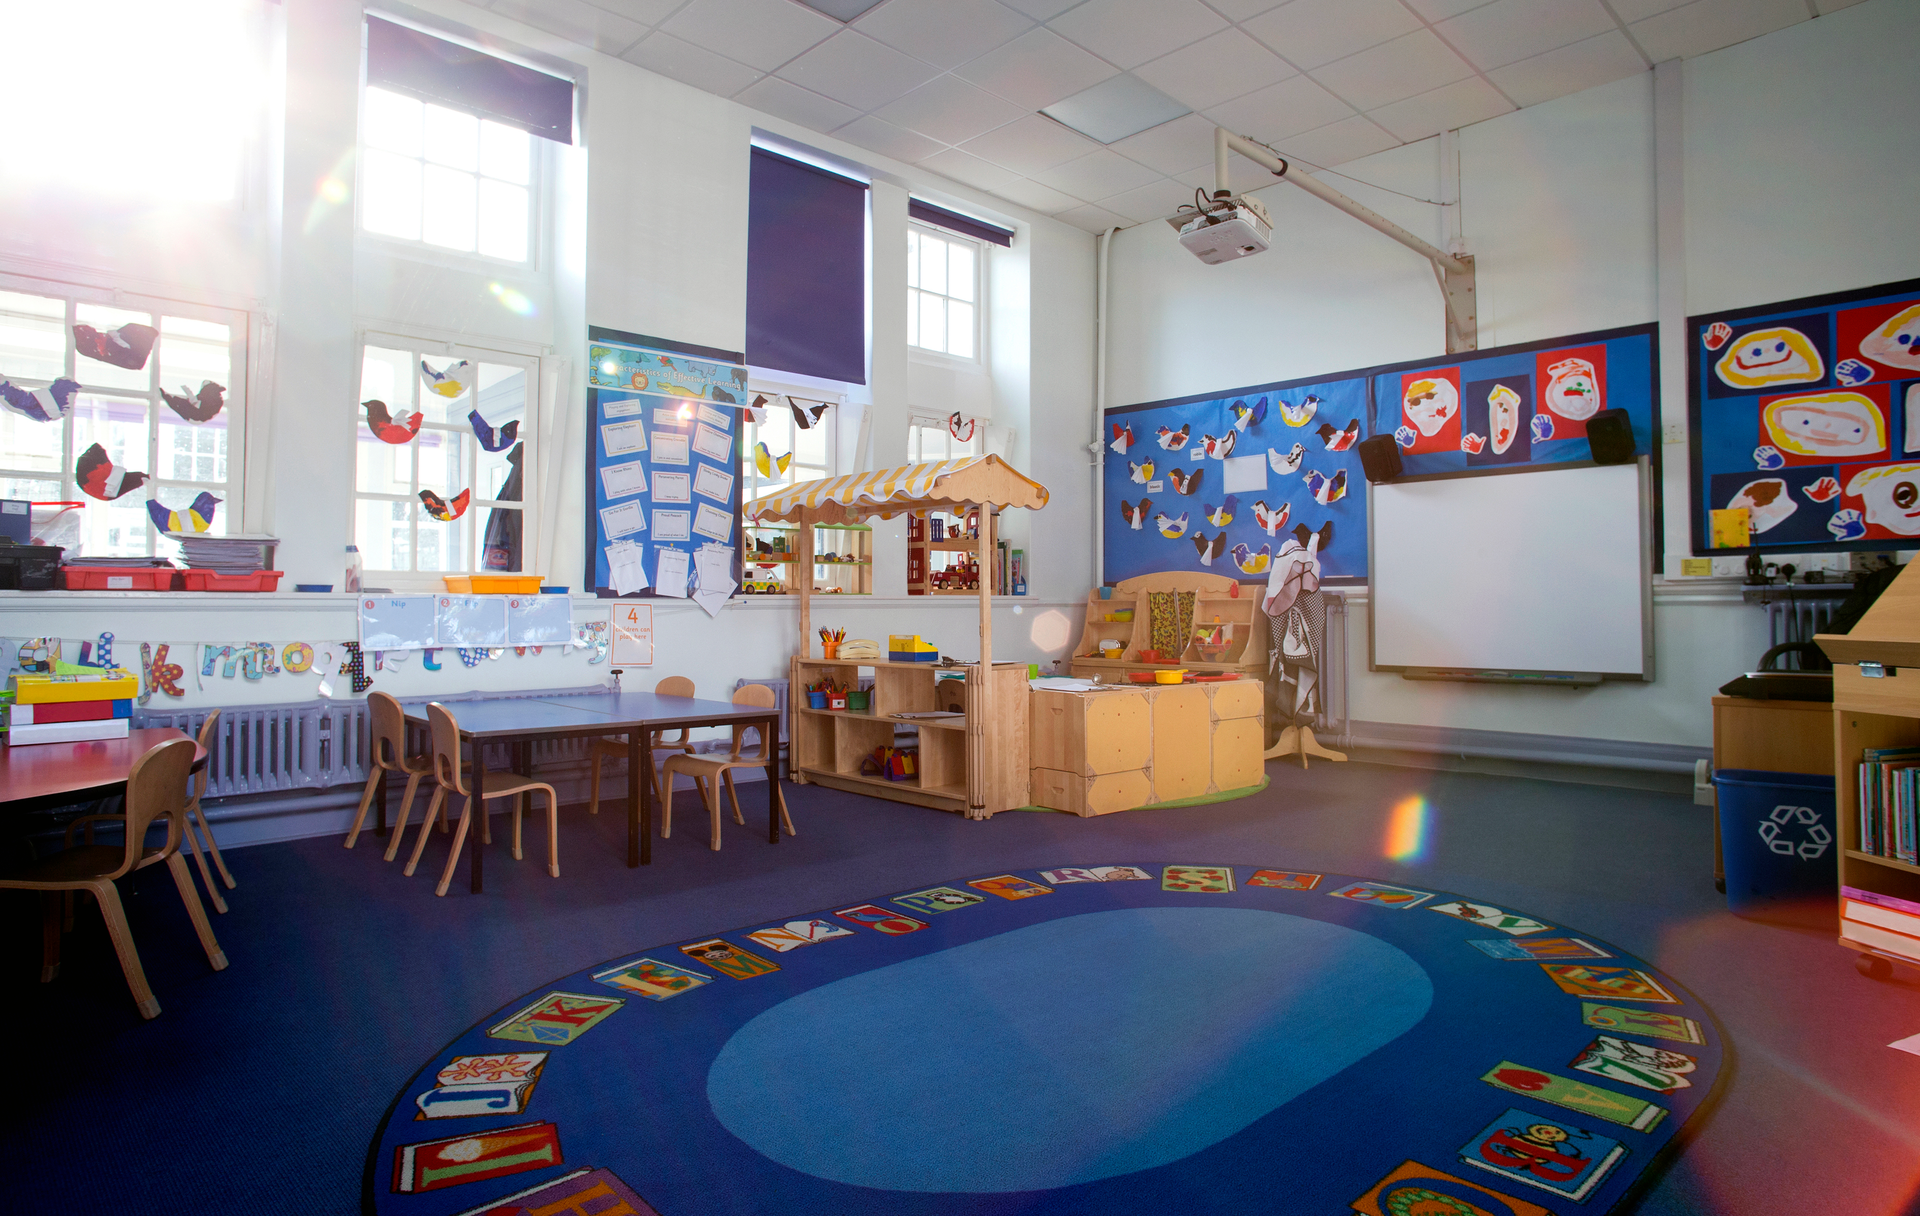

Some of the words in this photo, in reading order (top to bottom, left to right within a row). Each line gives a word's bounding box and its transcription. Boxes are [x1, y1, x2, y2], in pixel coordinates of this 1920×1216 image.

[598, 361, 661, 377] Cracteristics
[663, 370, 672, 381] of
[673, 371, 706, 383] Effective
[708, 377, 741, 391] Learning
[391, 600, 407, 609] Nip
[464, 599, 479, 609] Fp
[627, 607, 638, 624] 4
[151, 643, 185, 697] k
[202, 644, 263, 680] m
[282, 642, 314, 673] o
[1047, 867, 1089, 884] R
[1496, 915, 1546, 929] V
[748, 928, 801, 949] N
[708, 954, 773, 978] M
[527, 998, 615, 1027] K
[423, 1088, 512, 1109] J
[1479, 1127, 1593, 1182] B
